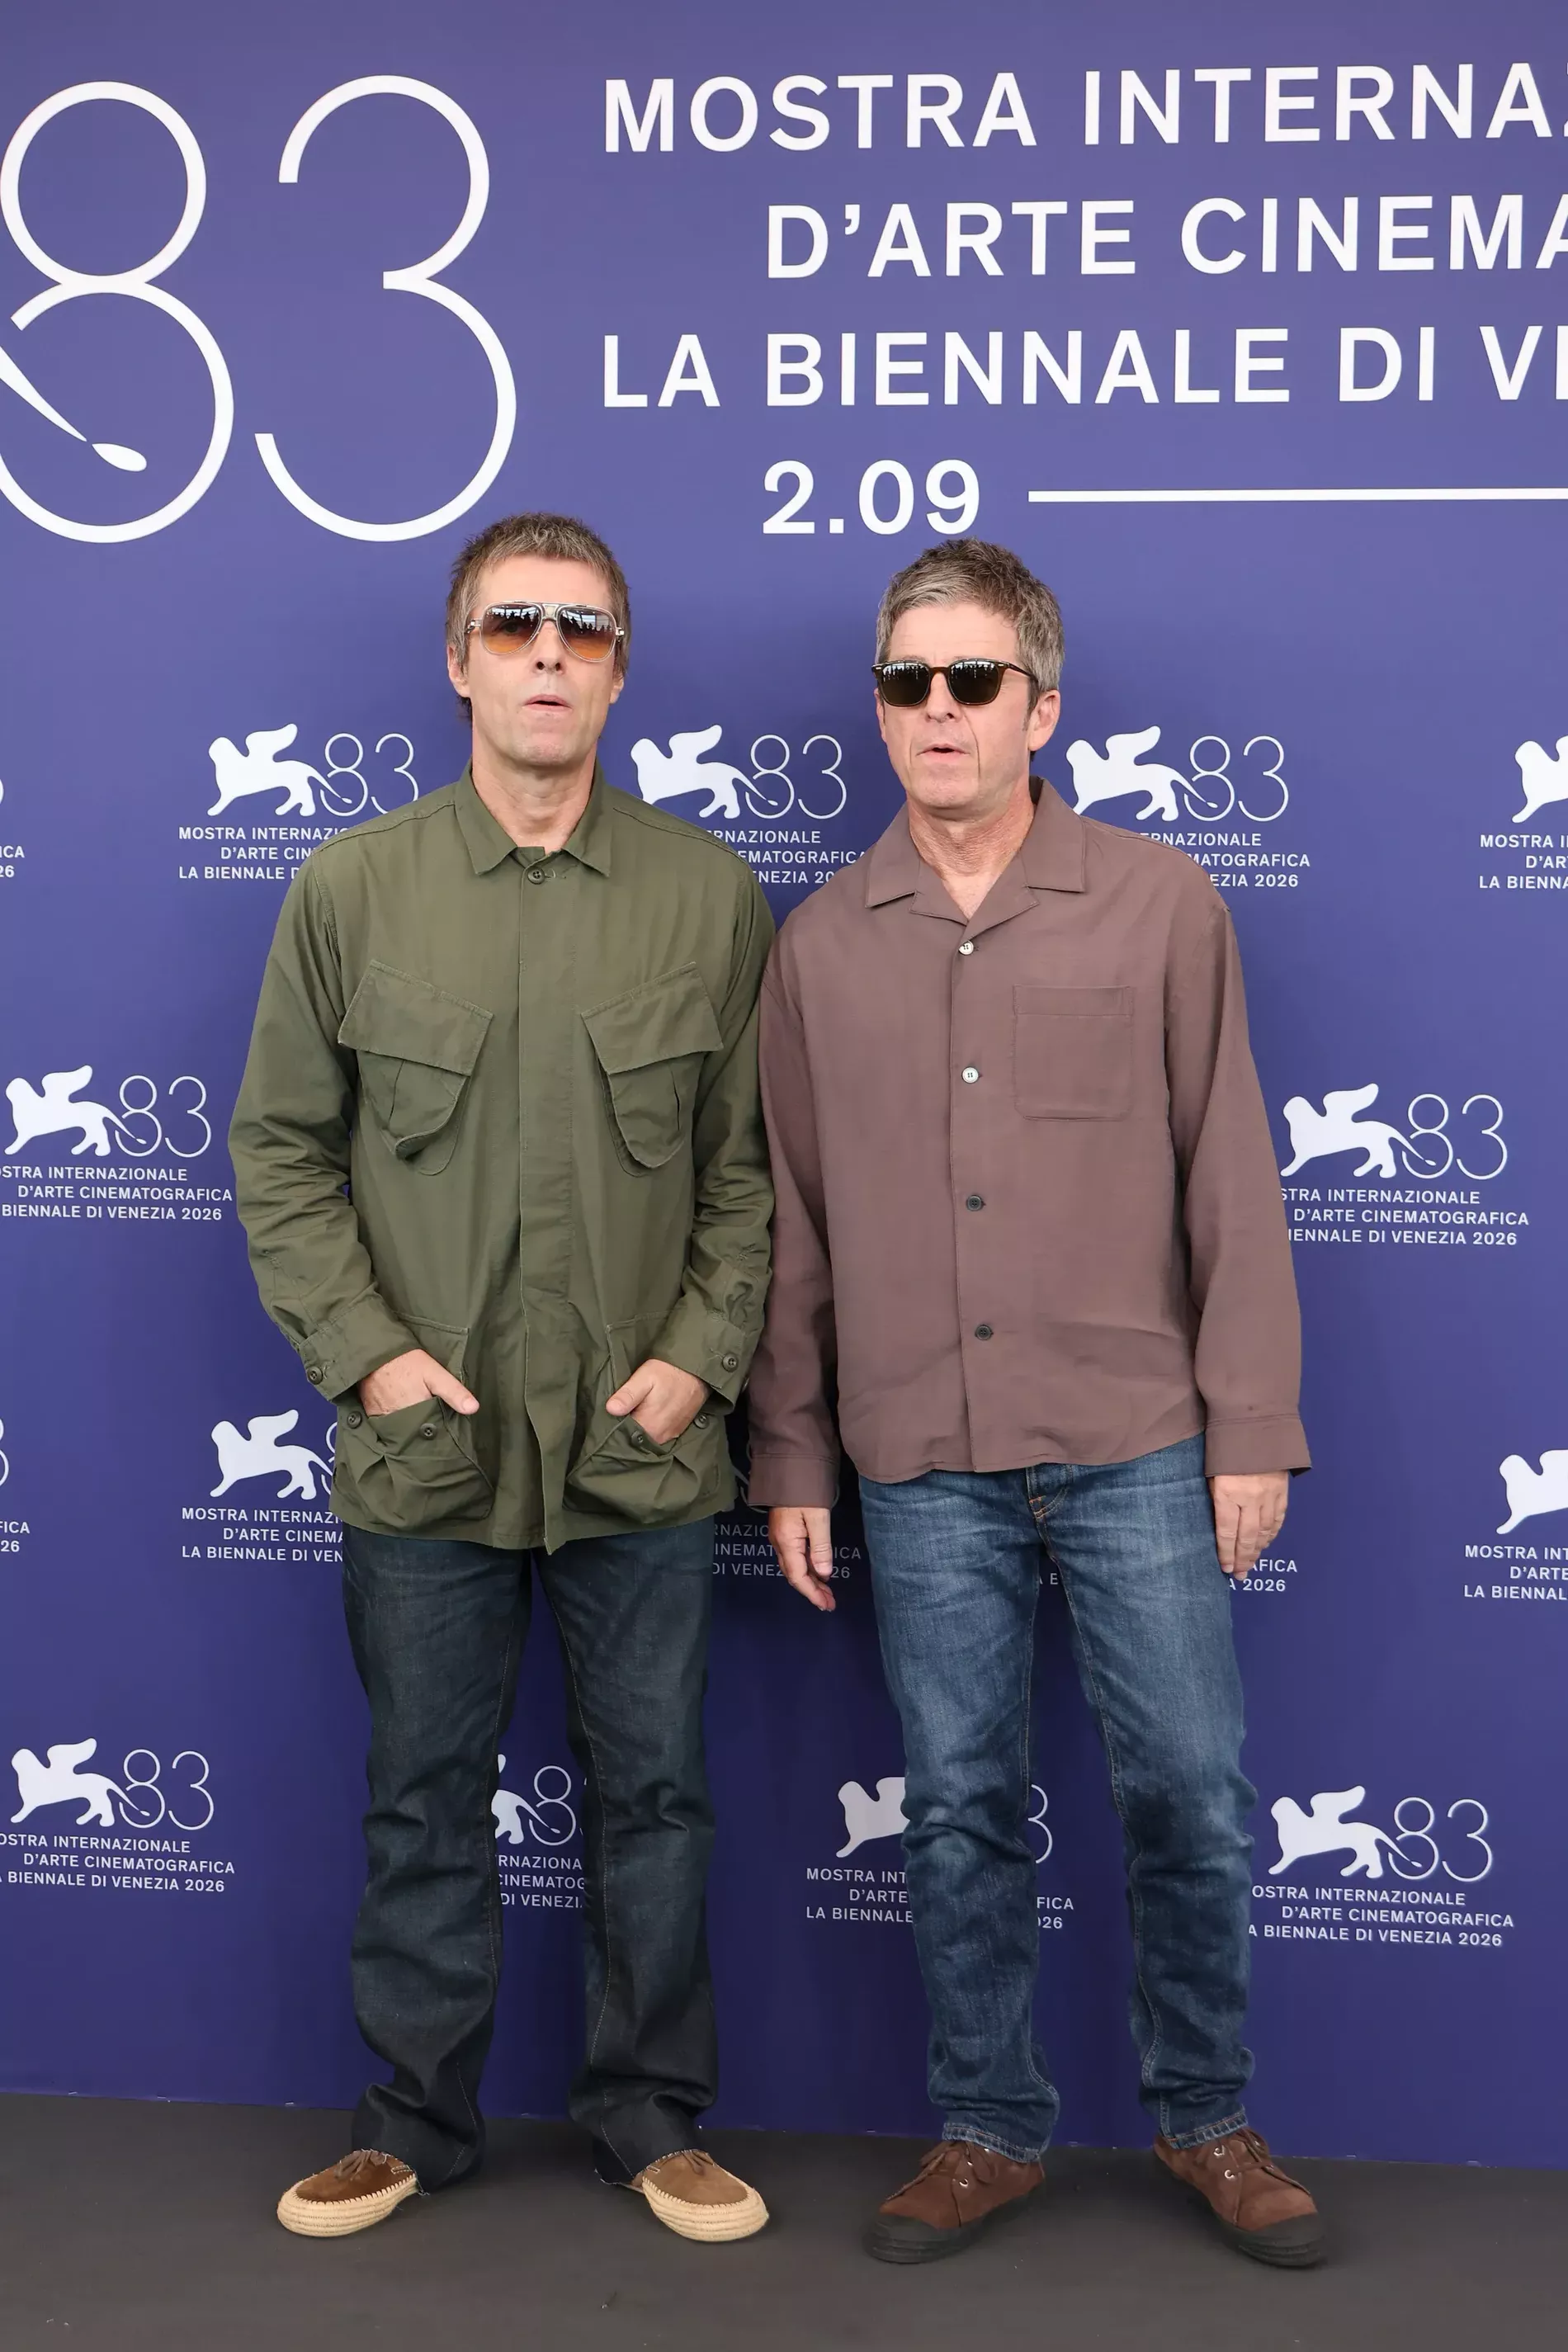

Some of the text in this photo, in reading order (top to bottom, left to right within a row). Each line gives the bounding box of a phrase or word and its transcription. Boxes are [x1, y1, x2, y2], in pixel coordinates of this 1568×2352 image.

[605, 63, 1568, 153] MOSTRA INTERNA
[0, 75, 517, 544] 83
[604, 325, 1568, 408] LA BIENNALE DI V
[763, 459, 980, 535] 2.09
[745, 734, 847, 819] 83
[1184, 735, 1289, 822] 83
[178, 826, 246, 840] MOSTRA
[1480, 834, 1554, 848] MOSTRA
[179, 866, 199, 879] LA
[204, 866, 285, 880] BIENNALE
[1254, 874, 1298, 887] 2026
[1479, 876, 1500, 889] LA
[115, 1074, 211, 1158] 83
[1401, 1093, 1508, 1180] 83
[0, 1165, 187, 1181] STRA INTERNAZIONALE
[79, 1186, 233, 1202] CINEMATOGRAFICA
[1328, 1188, 1481, 1204] INTERNAZIONALE
[2, 1204, 222, 1221] BIENNALE DI VENEZIA 2026
[1361, 1209, 1529, 1226] CINEMATOGRAFICA
[1368, 1230, 1386, 1243] DI
[1391, 1230, 1466, 1244] VENEZIA
[1472, 1231, 1517, 1245] 2026
[182, 1507, 248, 1522] MOSTRA
[182, 1545, 201, 1558] LA
[207, 1546, 286, 1561] BIENNALE
[292, 1549, 308, 1561] DI
[1465, 1544, 1538, 1560] MOSTRA
[1243, 1579, 1286, 1592] 2026
[1464, 1585, 1485, 1598] LA
[119, 1749, 215, 1830] 83
[54, 1835, 191, 1853] INTERNAZIONALE
[1387, 1797, 1493, 1882] 83
[84, 1855, 235, 1874] CINEMATOGRAFICA
[498, 1854, 583, 1870] RNAZIONA
[7, 1871, 86, 1887] BIENNALE
[91, 1874, 106, 1887] DI
[111, 1875, 179, 1891] VENEZIA
[185, 1878, 224, 1892] 2026
[806, 1868, 876, 1882] MOSTRA
[520, 1894, 583, 1908] VENEZI
[1315, 1887, 1466, 1906] INTERNAZIONALE
[806, 1906, 914, 1923] LA BIENNALE
[1348, 1908, 1514, 1928] CINEMATOGRAFICA
[1263, 1925, 1349, 1940] BIENNALE
[1356, 1928, 1372, 1941] DI
[1377, 1929, 1452, 1944] VENEZIA
[1458, 1932, 1502, 1947] 2026
